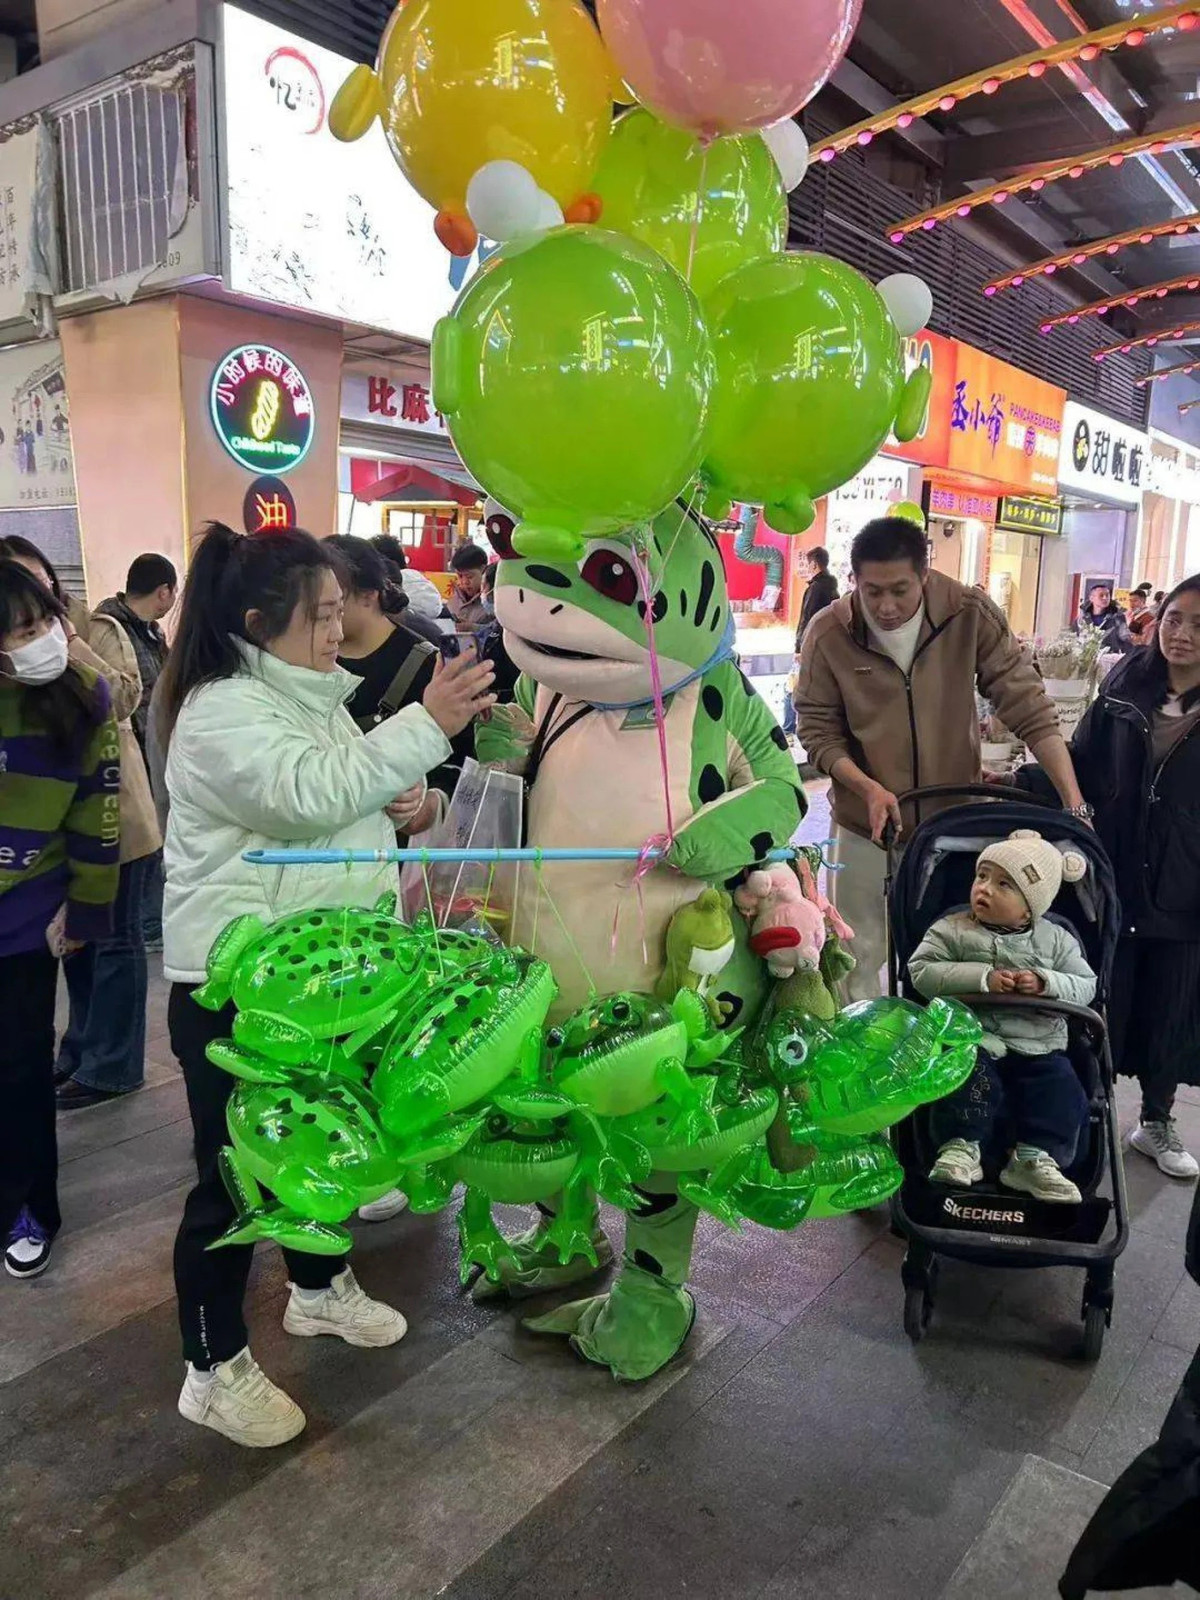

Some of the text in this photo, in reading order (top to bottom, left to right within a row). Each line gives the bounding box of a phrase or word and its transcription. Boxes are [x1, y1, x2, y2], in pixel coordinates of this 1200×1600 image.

[216, 350, 310, 417] 小时候的味道
[367, 375, 446, 428] 比麻
[254, 492, 288, 534] 油
[943, 1197, 1025, 1224] SKECHERS
